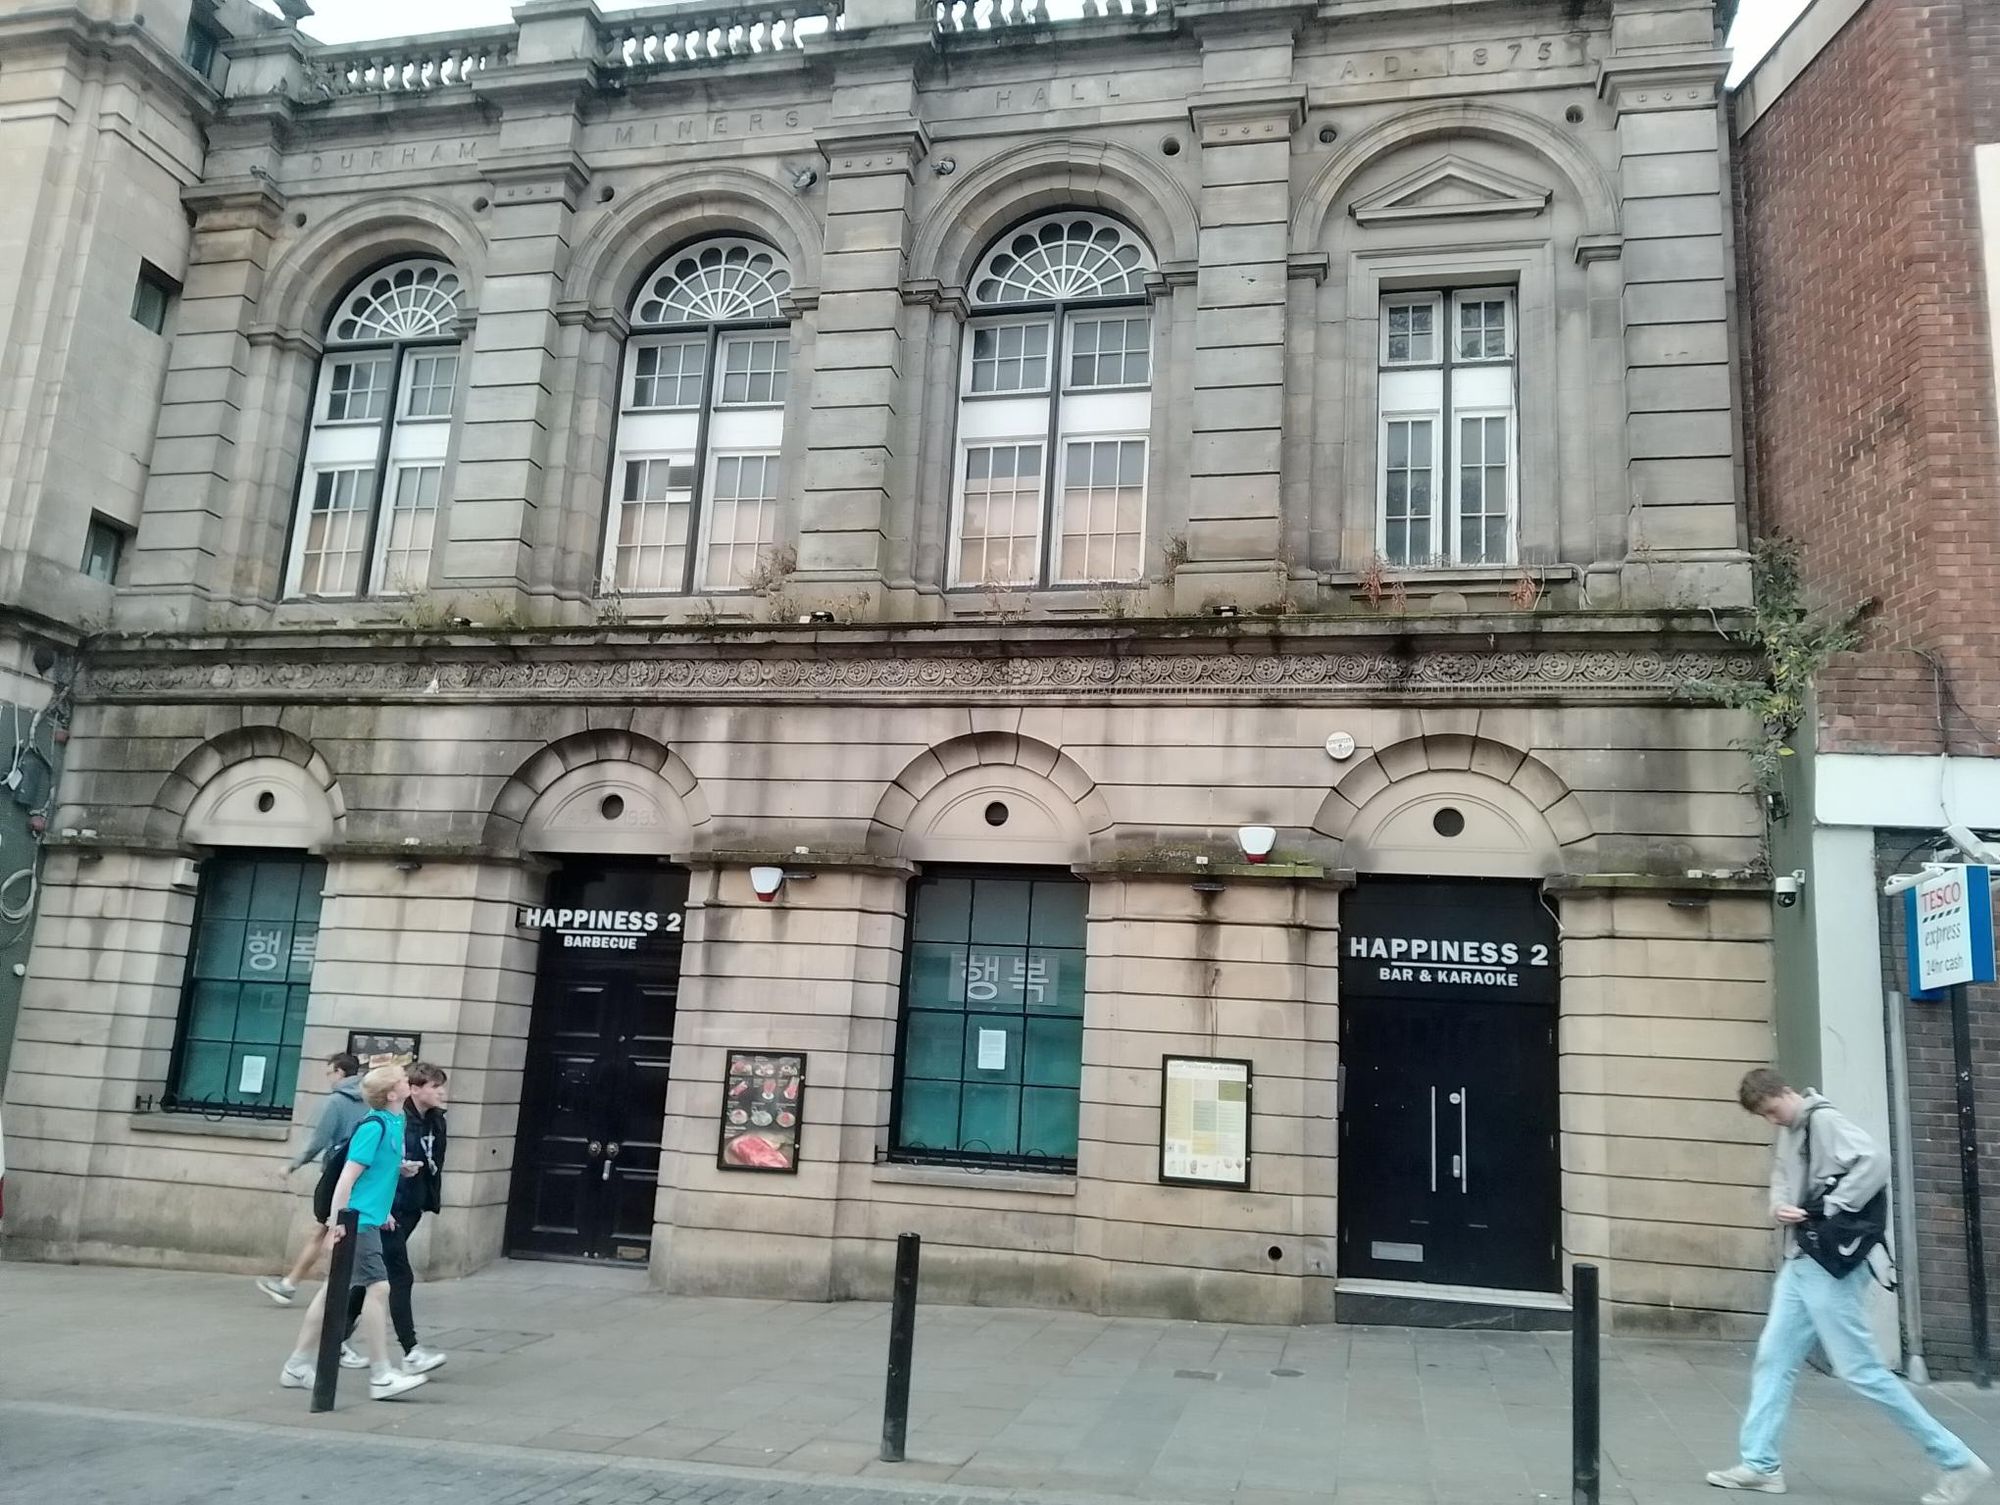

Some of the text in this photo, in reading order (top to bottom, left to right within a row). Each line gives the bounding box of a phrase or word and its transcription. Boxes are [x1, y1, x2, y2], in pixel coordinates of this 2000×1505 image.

[1450, 42, 1552, 70] 1875
[311, 80, 1121, 173] DURHAM MINERS HALL
[1921, 881, 1961, 912] TESCO
[526, 908, 682, 932] HAPPINESS 2
[563, 935, 637, 950] BARBECUE
[1925, 922, 1961, 950] express
[1350, 936, 1549, 966] HAPPINESS 2
[1944, 953, 1964, 972] cash
[1379, 967, 1519, 986] BAR & KARAOKE
